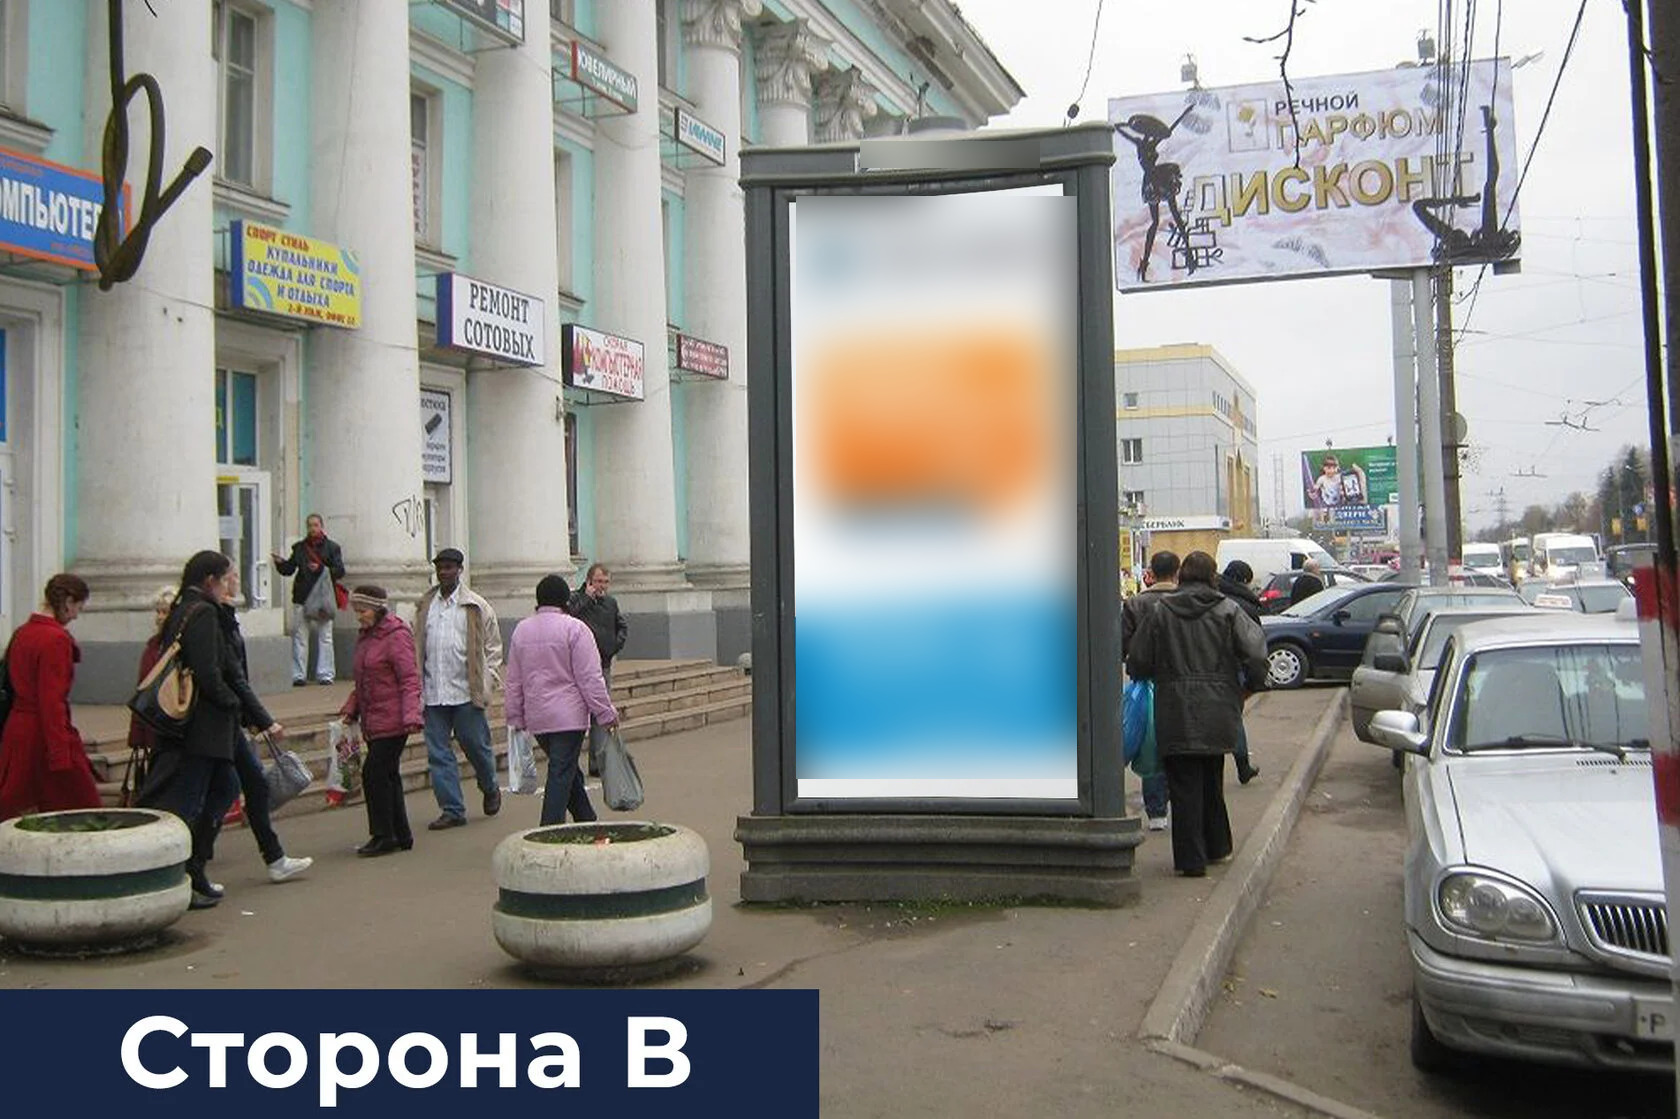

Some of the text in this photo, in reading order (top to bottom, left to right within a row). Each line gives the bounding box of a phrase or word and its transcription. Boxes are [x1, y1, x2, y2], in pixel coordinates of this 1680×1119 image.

[1275, 93, 1359, 116] РЕЧНОЙ
[1276, 108, 1445, 149] ПАРФЮМ
[1193, 153, 1474, 227] ДИСКОНТ
[248, 259, 355, 297] ОДЕЖДА ДЛЯ СПОРТА
[267, 245, 338, 273] КУПАЛЬНИКИ
[277, 284, 330, 308] И ОТДЫХА
[470, 282, 529, 323] РЕМОНТ
[464, 318, 535, 360] СОТОВЫХ
